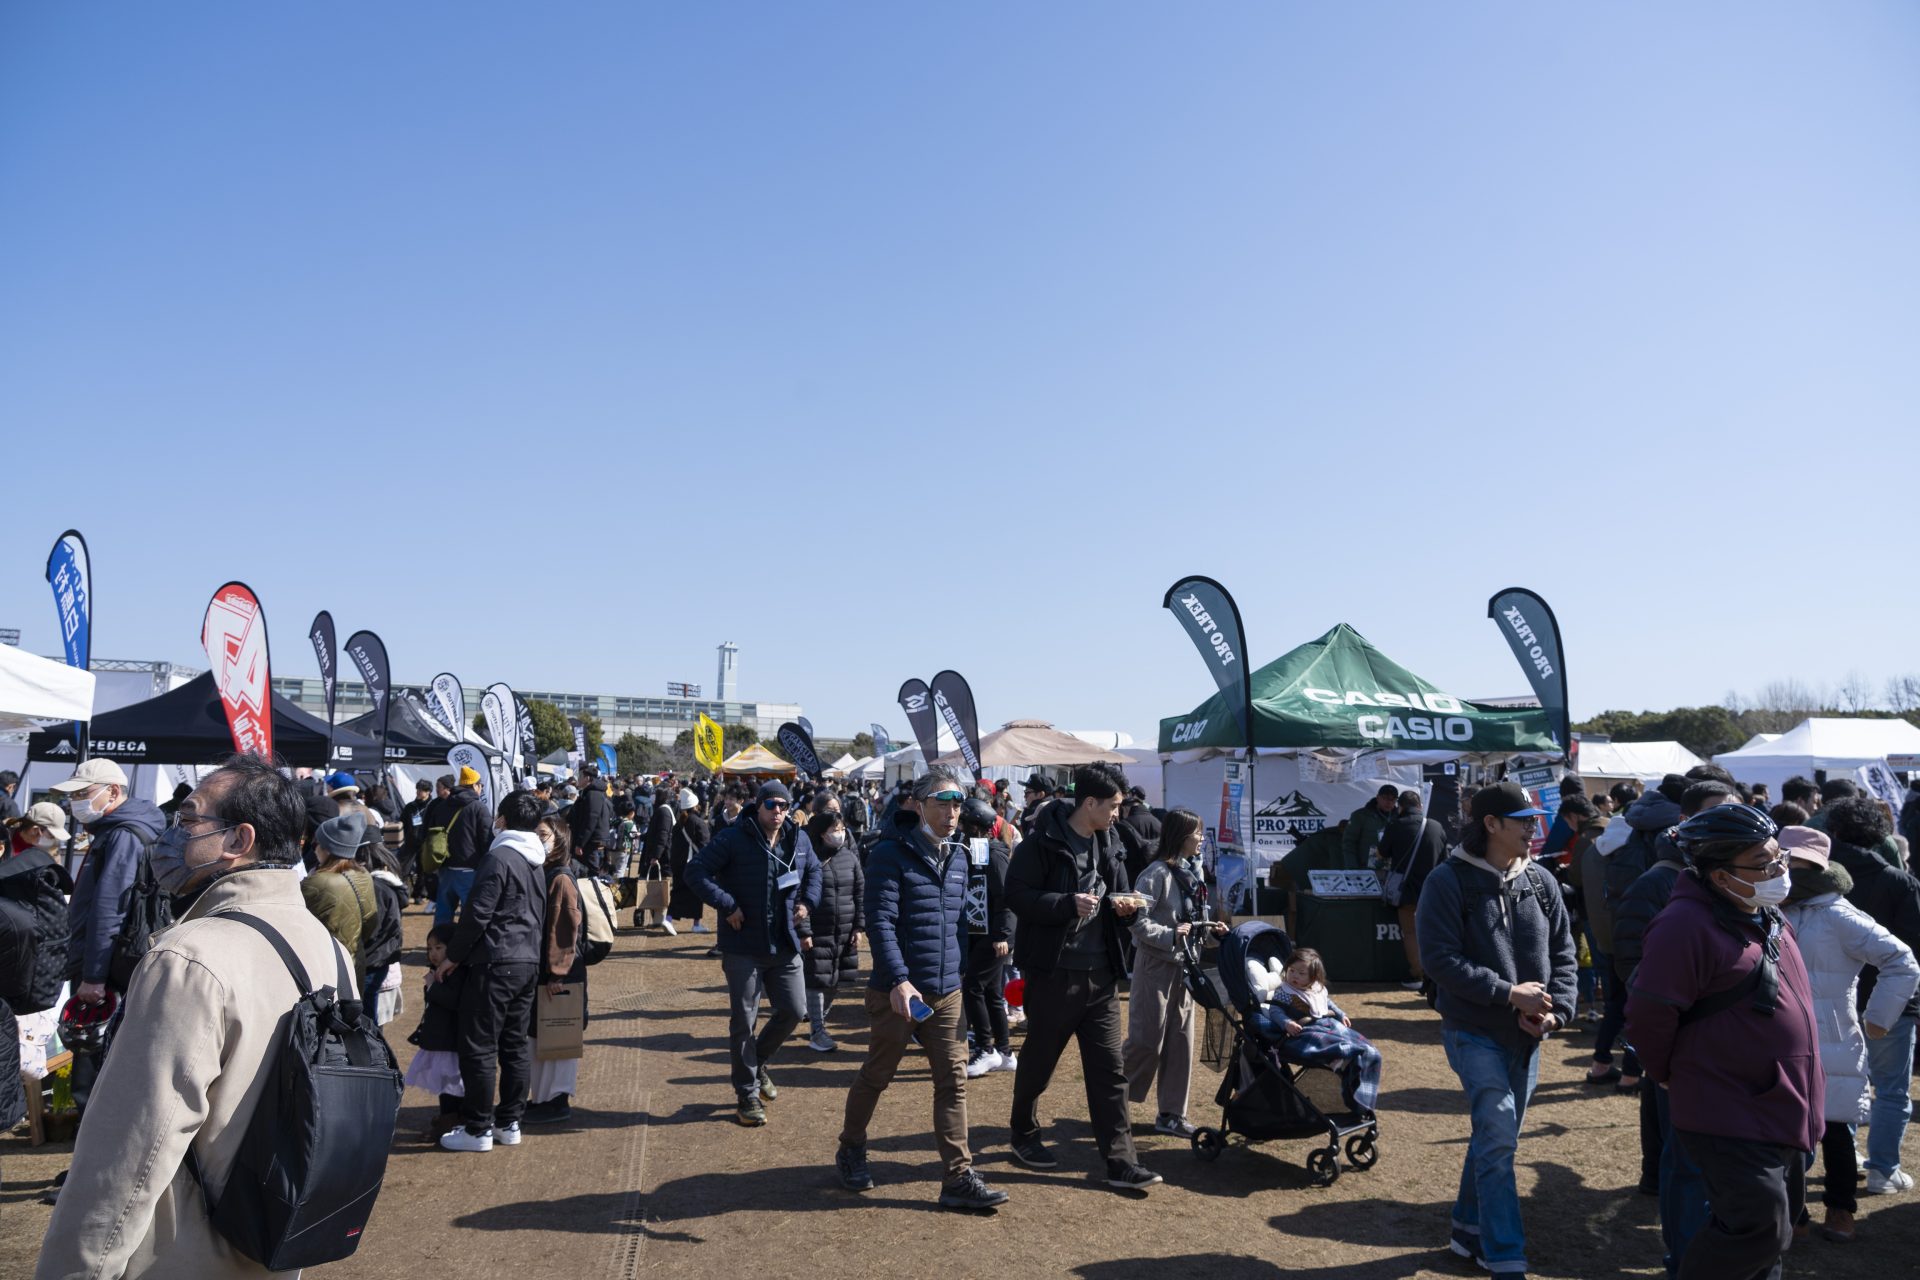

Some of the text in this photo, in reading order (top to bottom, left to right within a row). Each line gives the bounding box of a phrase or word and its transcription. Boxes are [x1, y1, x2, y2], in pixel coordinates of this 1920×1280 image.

[1302, 687, 1463, 713] CASIO
[942, 706, 980, 772] GREBE WORKS
[1171, 719, 1208, 743] CASIO
[1357, 715, 1474, 742] CASIO
[87, 740, 147, 752] FEDECA
[1256, 819, 1326, 832] PRO TREK
[1258, 838, 1273, 846] One
[1376, 923, 1405, 941] PR
